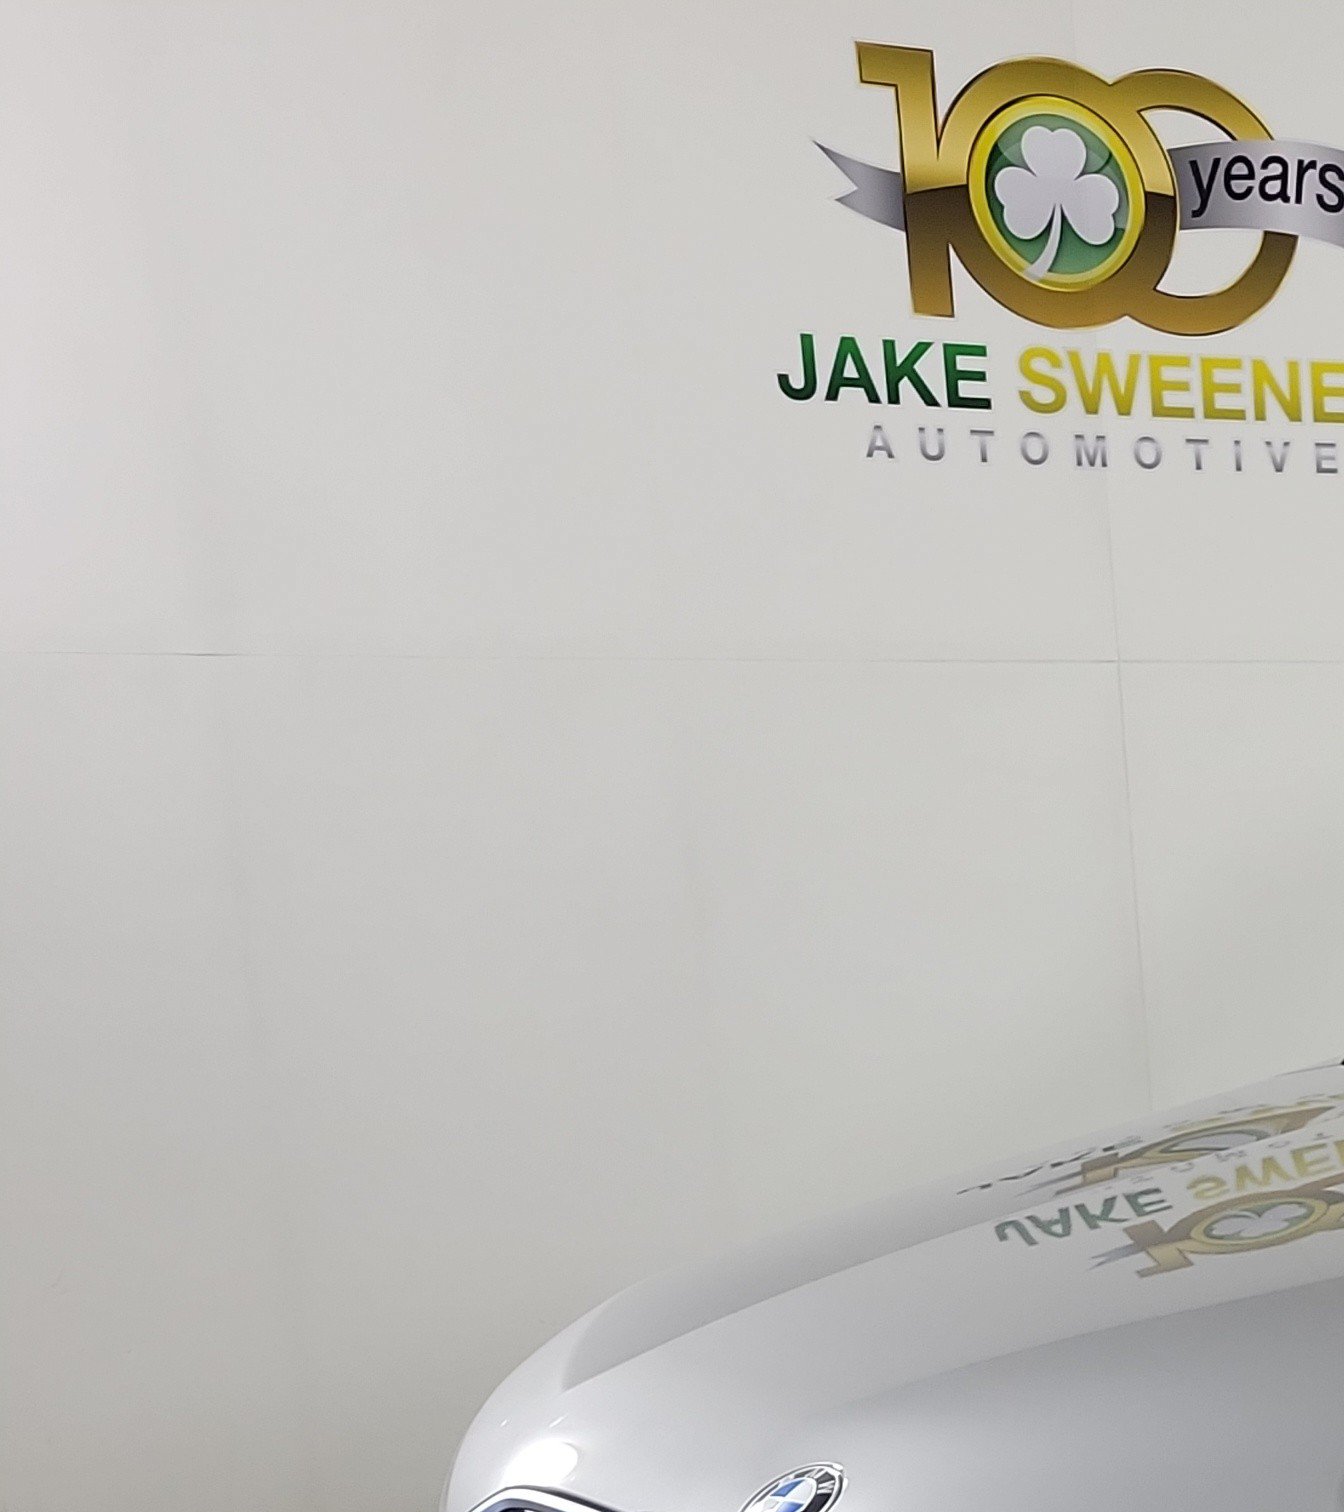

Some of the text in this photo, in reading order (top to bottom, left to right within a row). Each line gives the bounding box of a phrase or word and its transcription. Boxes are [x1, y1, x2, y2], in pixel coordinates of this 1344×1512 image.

[854, 40, 1300, 338] 100
[775, 332, 994, 411] JAKE
[864, 424, 1339, 475] AUTOMOTIVE
